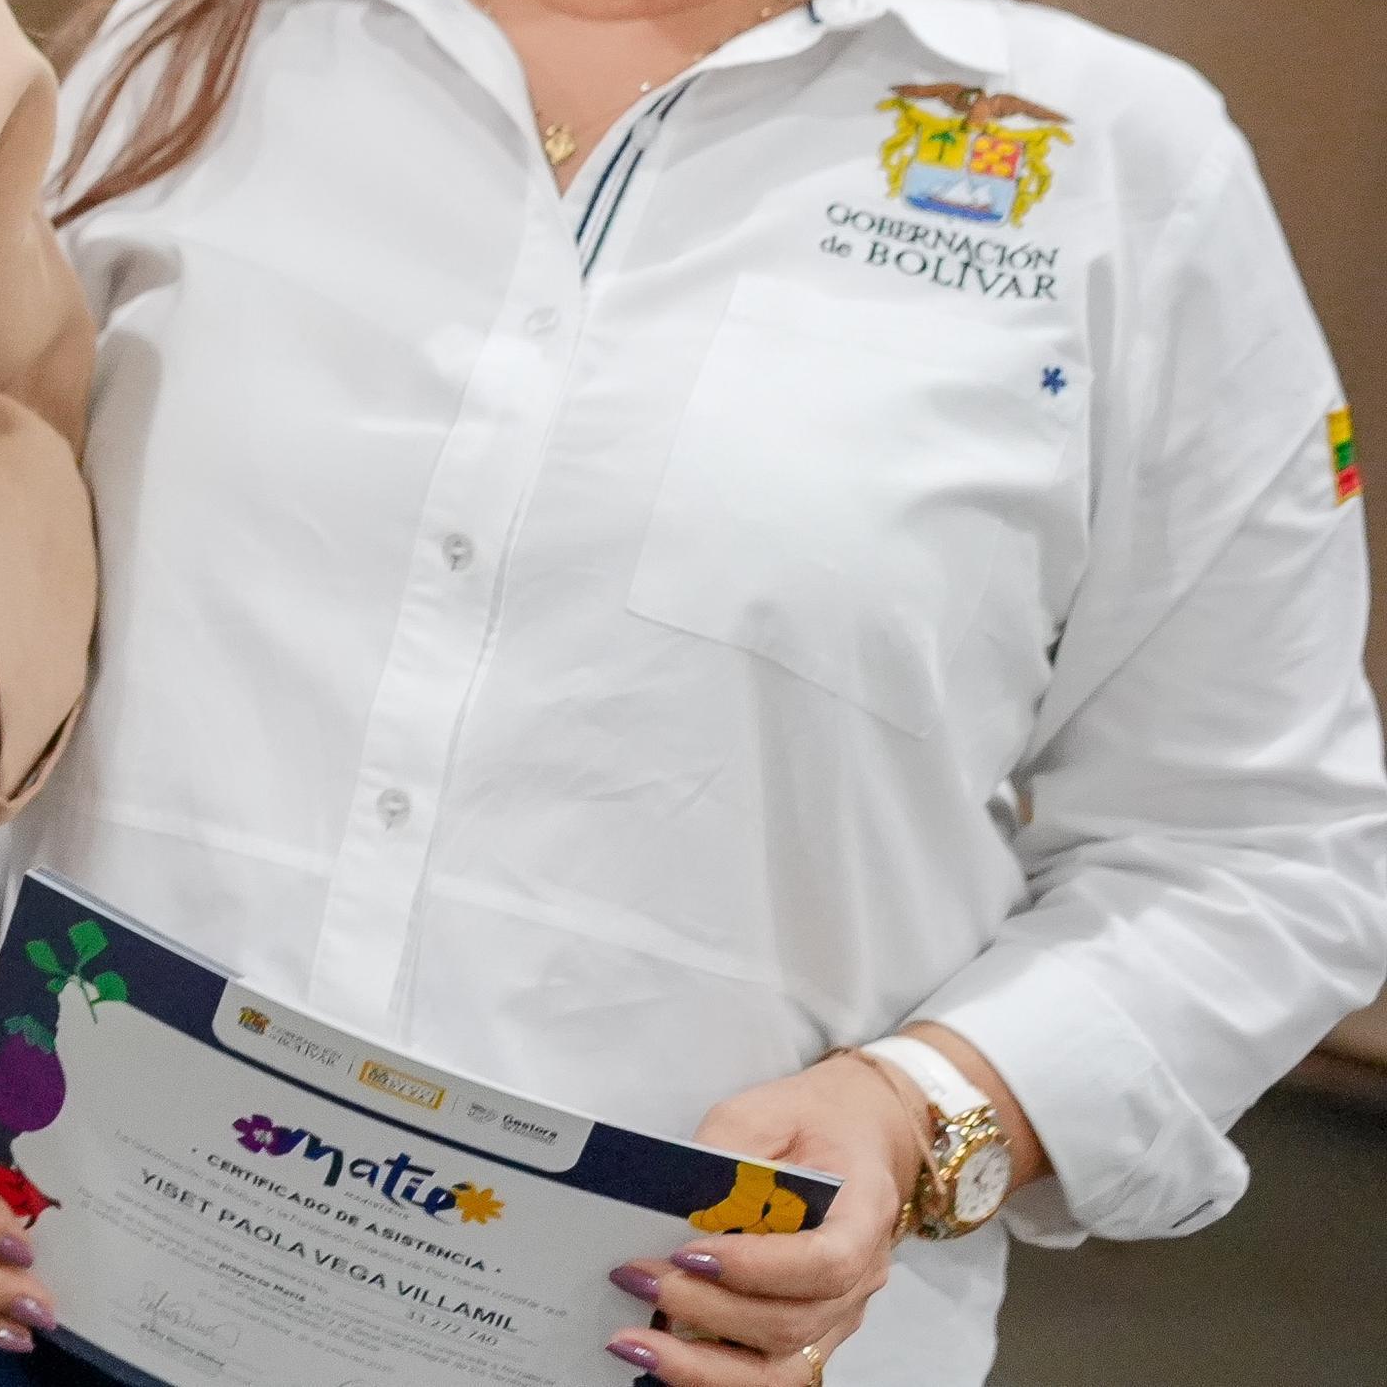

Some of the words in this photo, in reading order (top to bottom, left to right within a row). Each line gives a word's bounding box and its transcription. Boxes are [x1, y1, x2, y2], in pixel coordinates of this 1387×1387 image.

[820, 235, 852, 258] de
[865, 241, 1056, 300] BOLÍVAR
[826, 201, 1059, 270] GOBERNACIÓN
[137, 1168, 212, 1214] YISET
[217, 1207, 308, 1257] PAOLA
[312, 1248, 388, 1288] VEGA
[395, 1279, 520, 1332] VILLAMIL
[206, 1152, 331, 1215] CERTIFICADO
[335, 1208, 359, 1226] DE
[364, 1219, 487, 1272] ASISTENCIA
